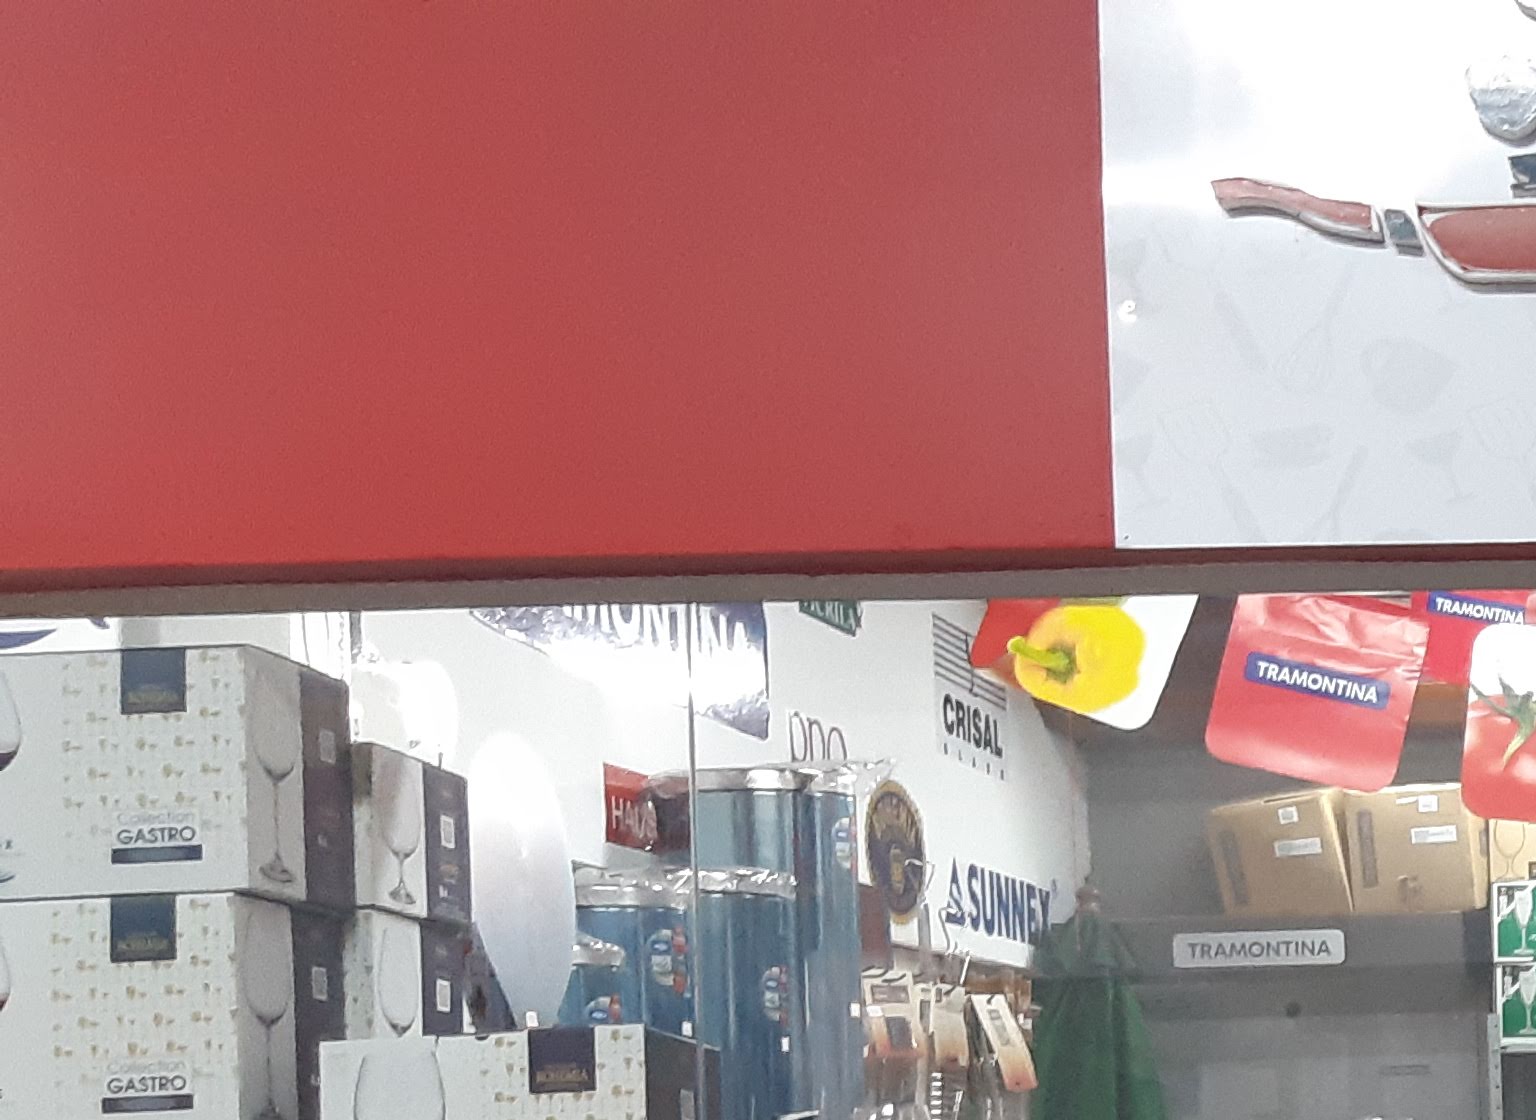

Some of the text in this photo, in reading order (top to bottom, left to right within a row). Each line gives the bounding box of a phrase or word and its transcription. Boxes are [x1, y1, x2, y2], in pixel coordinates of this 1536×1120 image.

[1435, 597, 1525, 625] TRAMONTINA
[1256, 661, 1379, 703] TRAMONTINA
[943, 694, 1002, 758] CRISAL
[117, 826, 195, 845] GASTRO
[967, 864, 1050, 944] SUNNEX
[1188, 938, 1331, 959] TRAMONTINA
[108, 1075, 187, 1094] GASTRO
